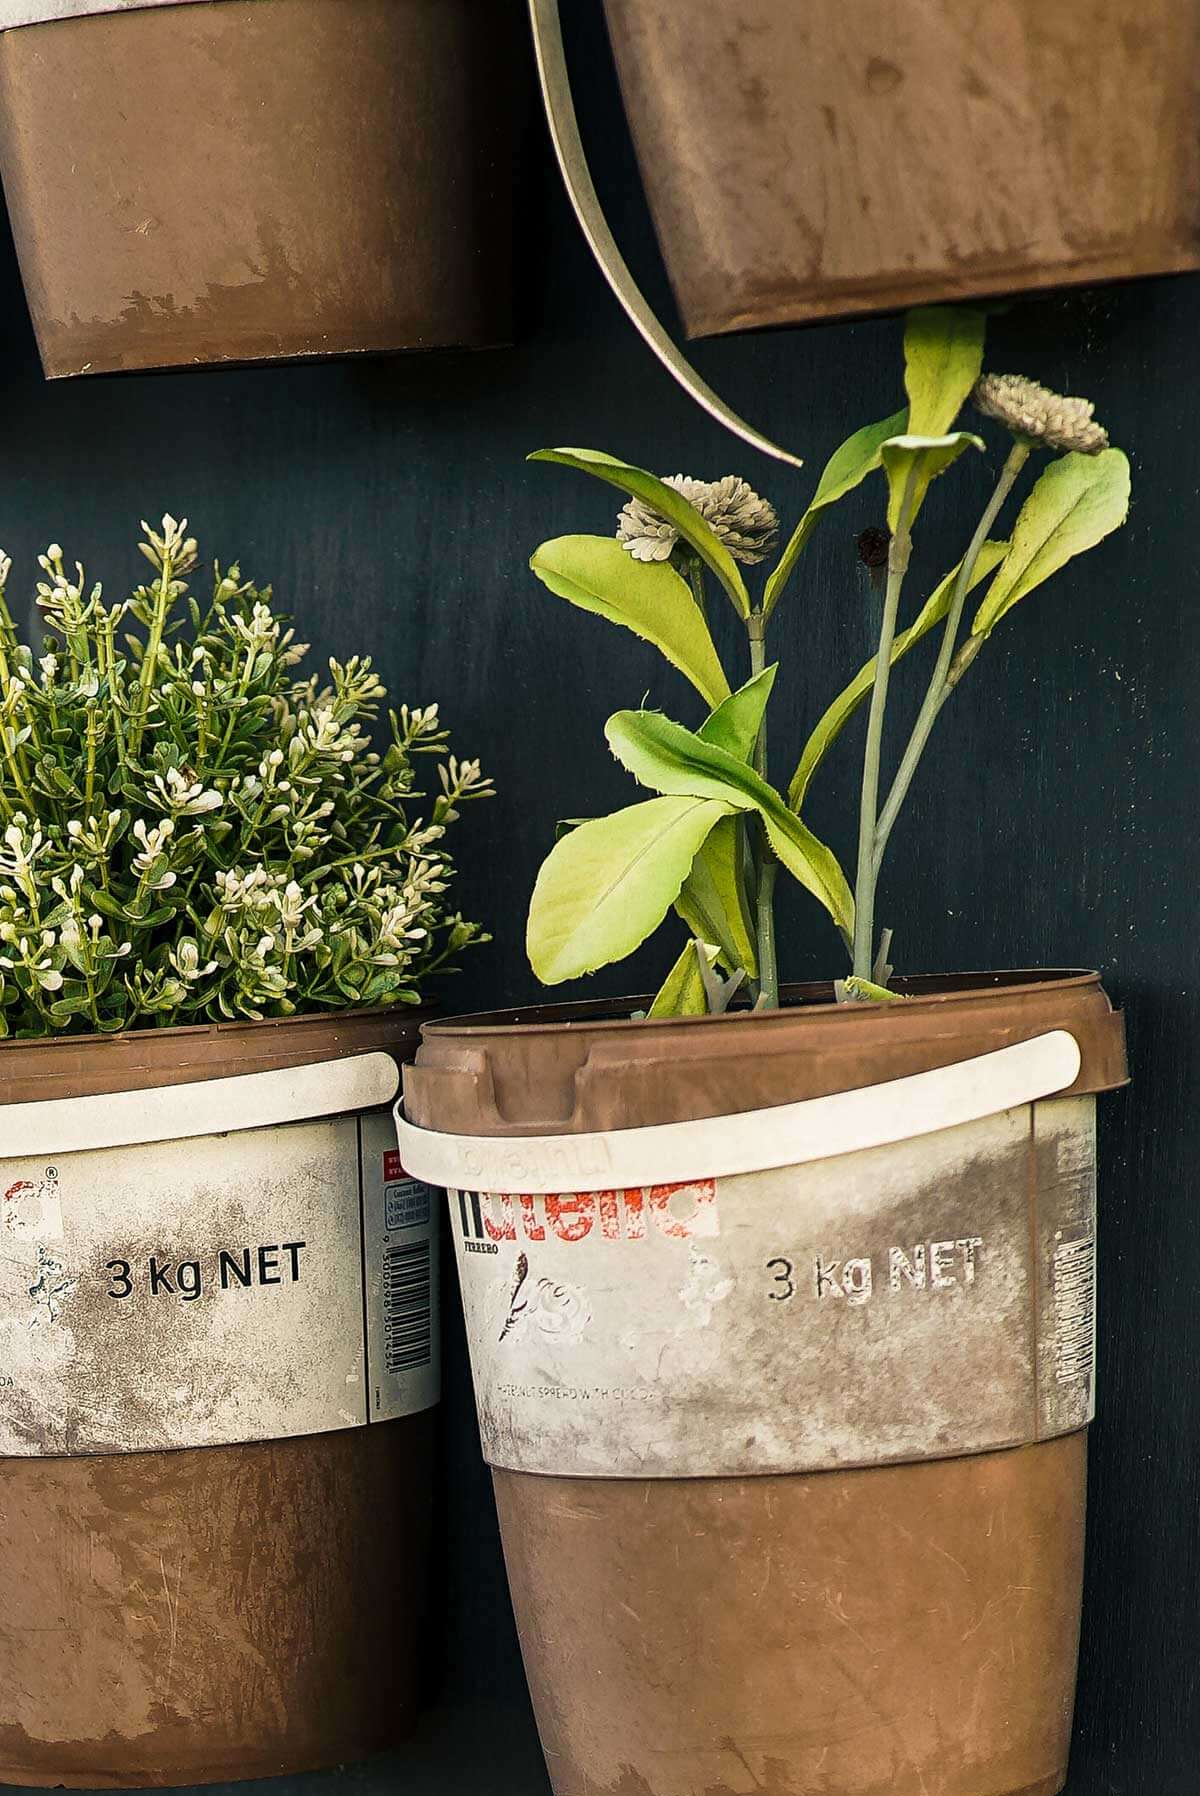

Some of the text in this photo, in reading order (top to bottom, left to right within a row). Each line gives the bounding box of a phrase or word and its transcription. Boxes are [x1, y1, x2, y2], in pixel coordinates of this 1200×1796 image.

[105, 1241, 307, 1301] 3 kg NET
[765, 1236, 983, 1307] 3 kg NET
